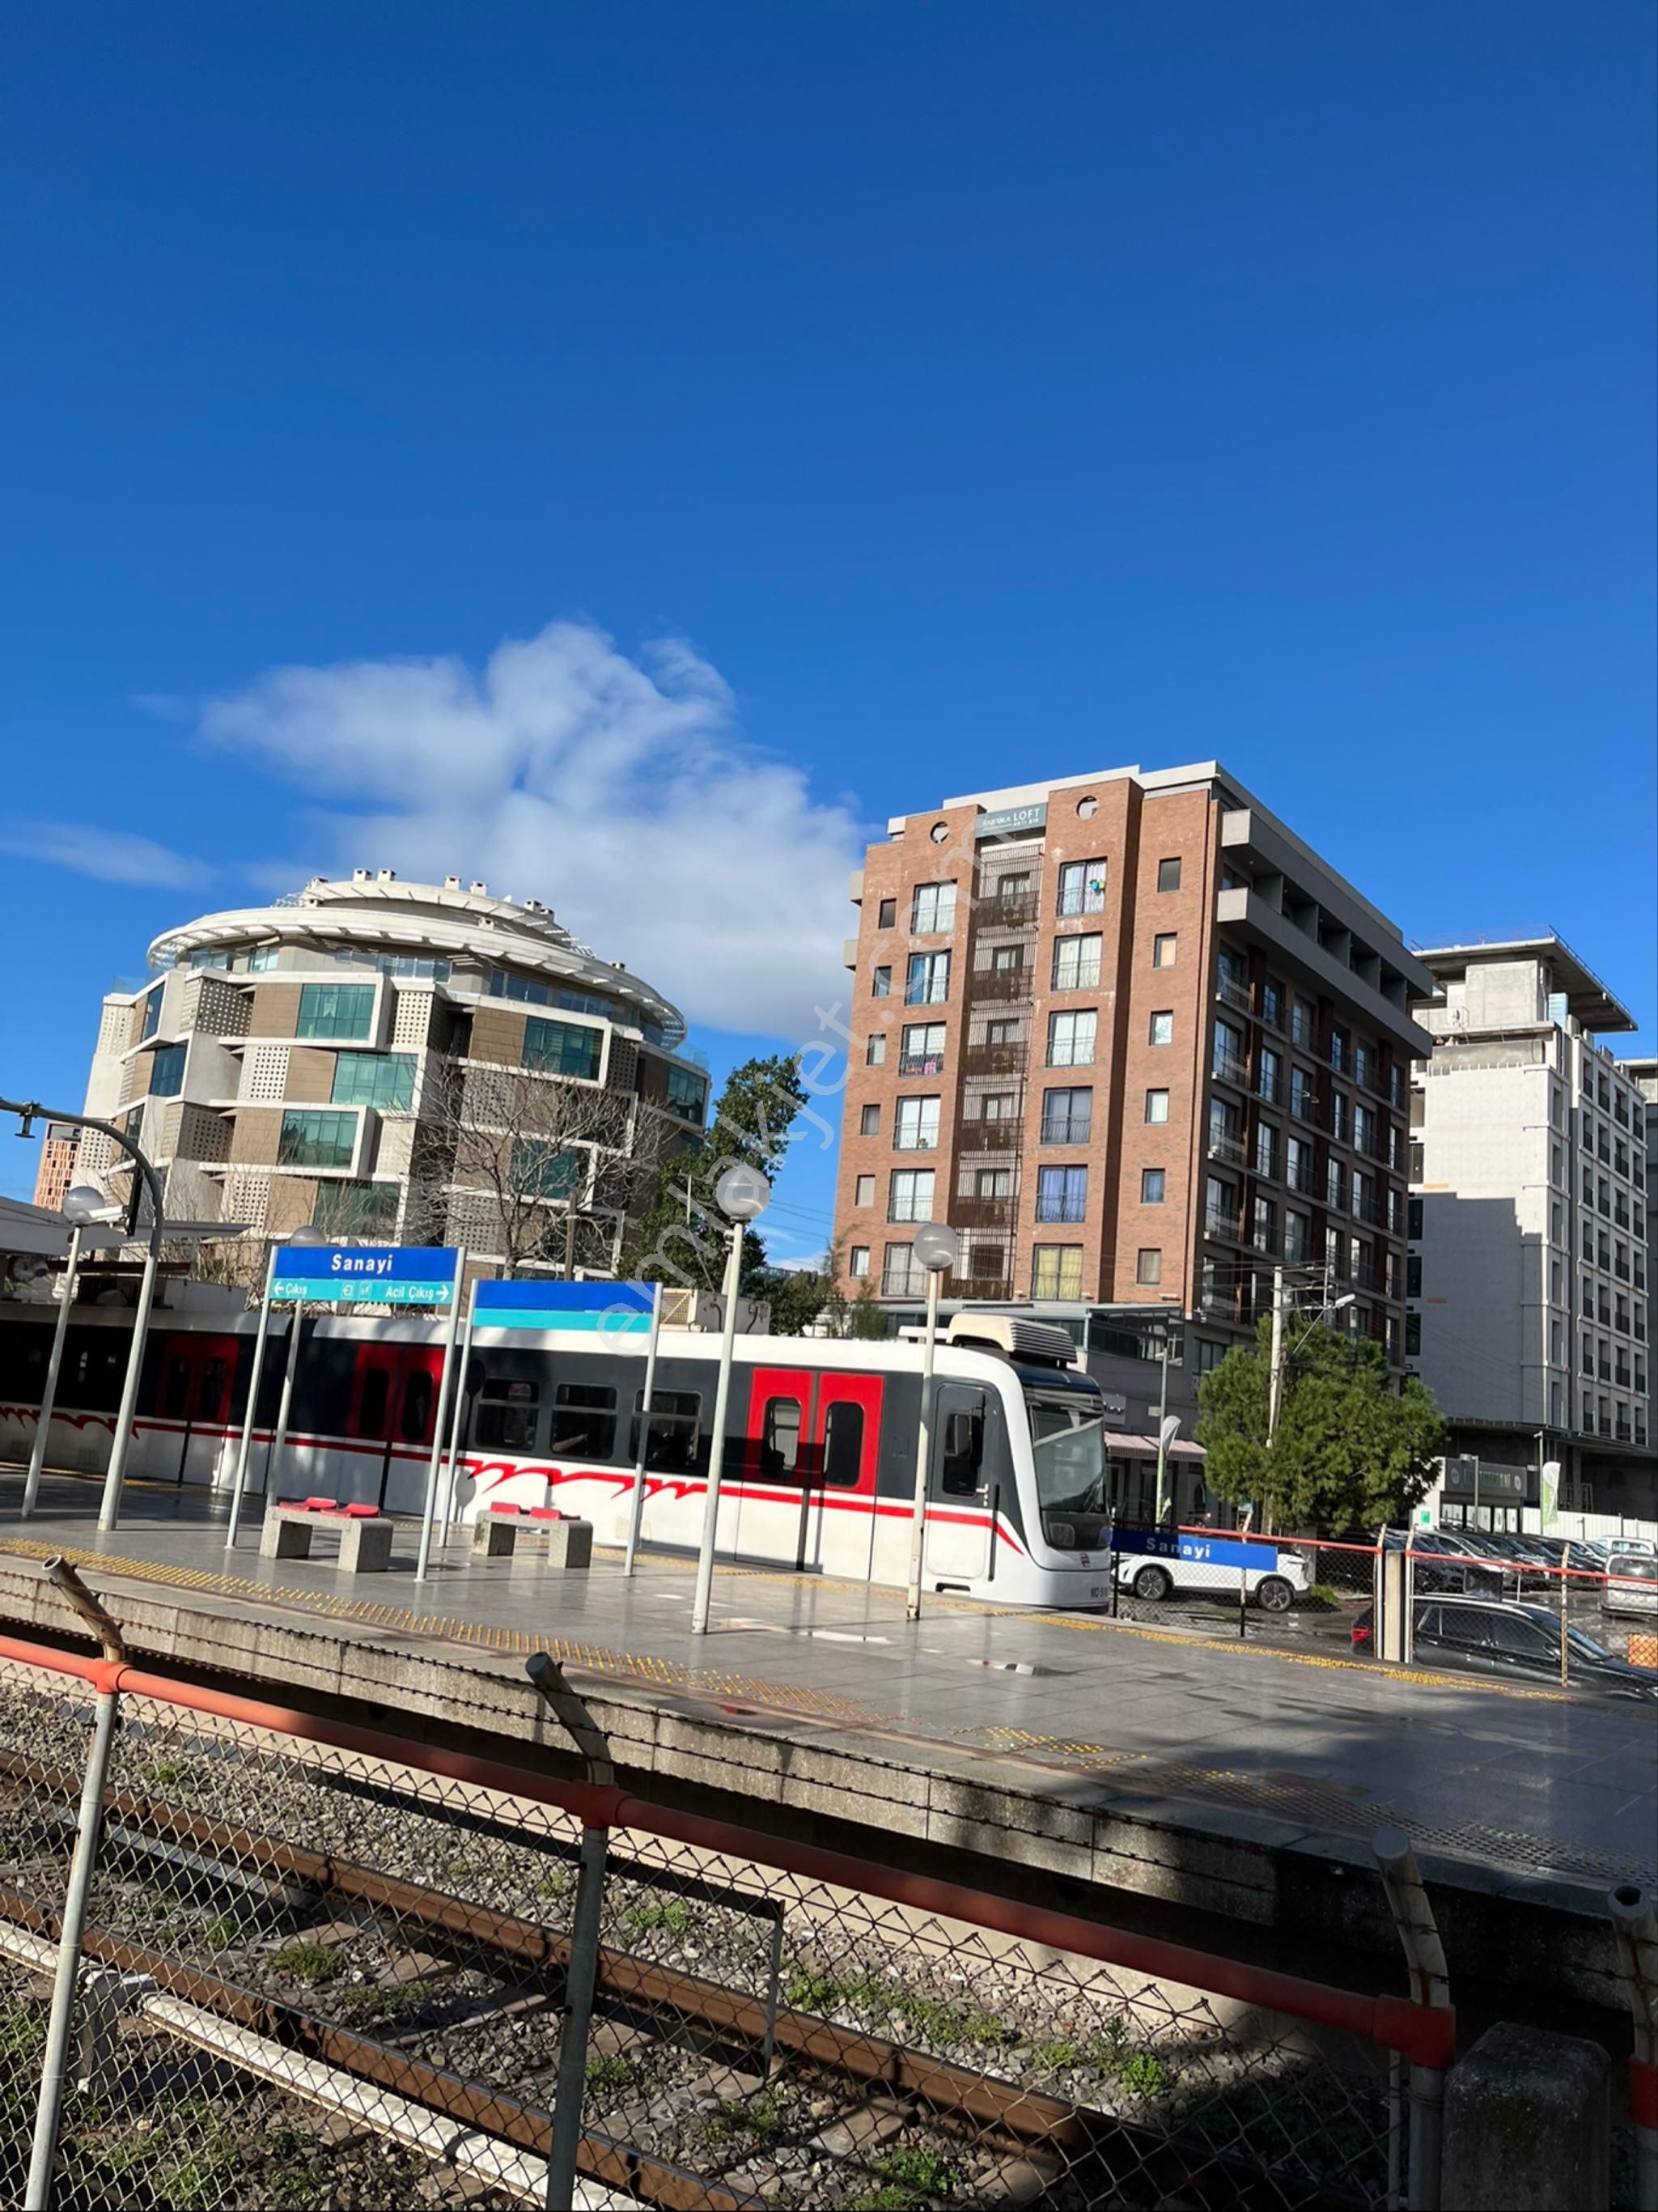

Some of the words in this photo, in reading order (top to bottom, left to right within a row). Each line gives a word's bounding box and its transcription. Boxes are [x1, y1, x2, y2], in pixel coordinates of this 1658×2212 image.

[1014, 808, 1040, 821] LOFT
[330, 1253, 393, 1275] Sanayi
[385, 1285, 405, 1298] Acil
[408, 1285, 435, 1301] Çıkış
[1146, 1537, 1211, 1559] Sanayi
